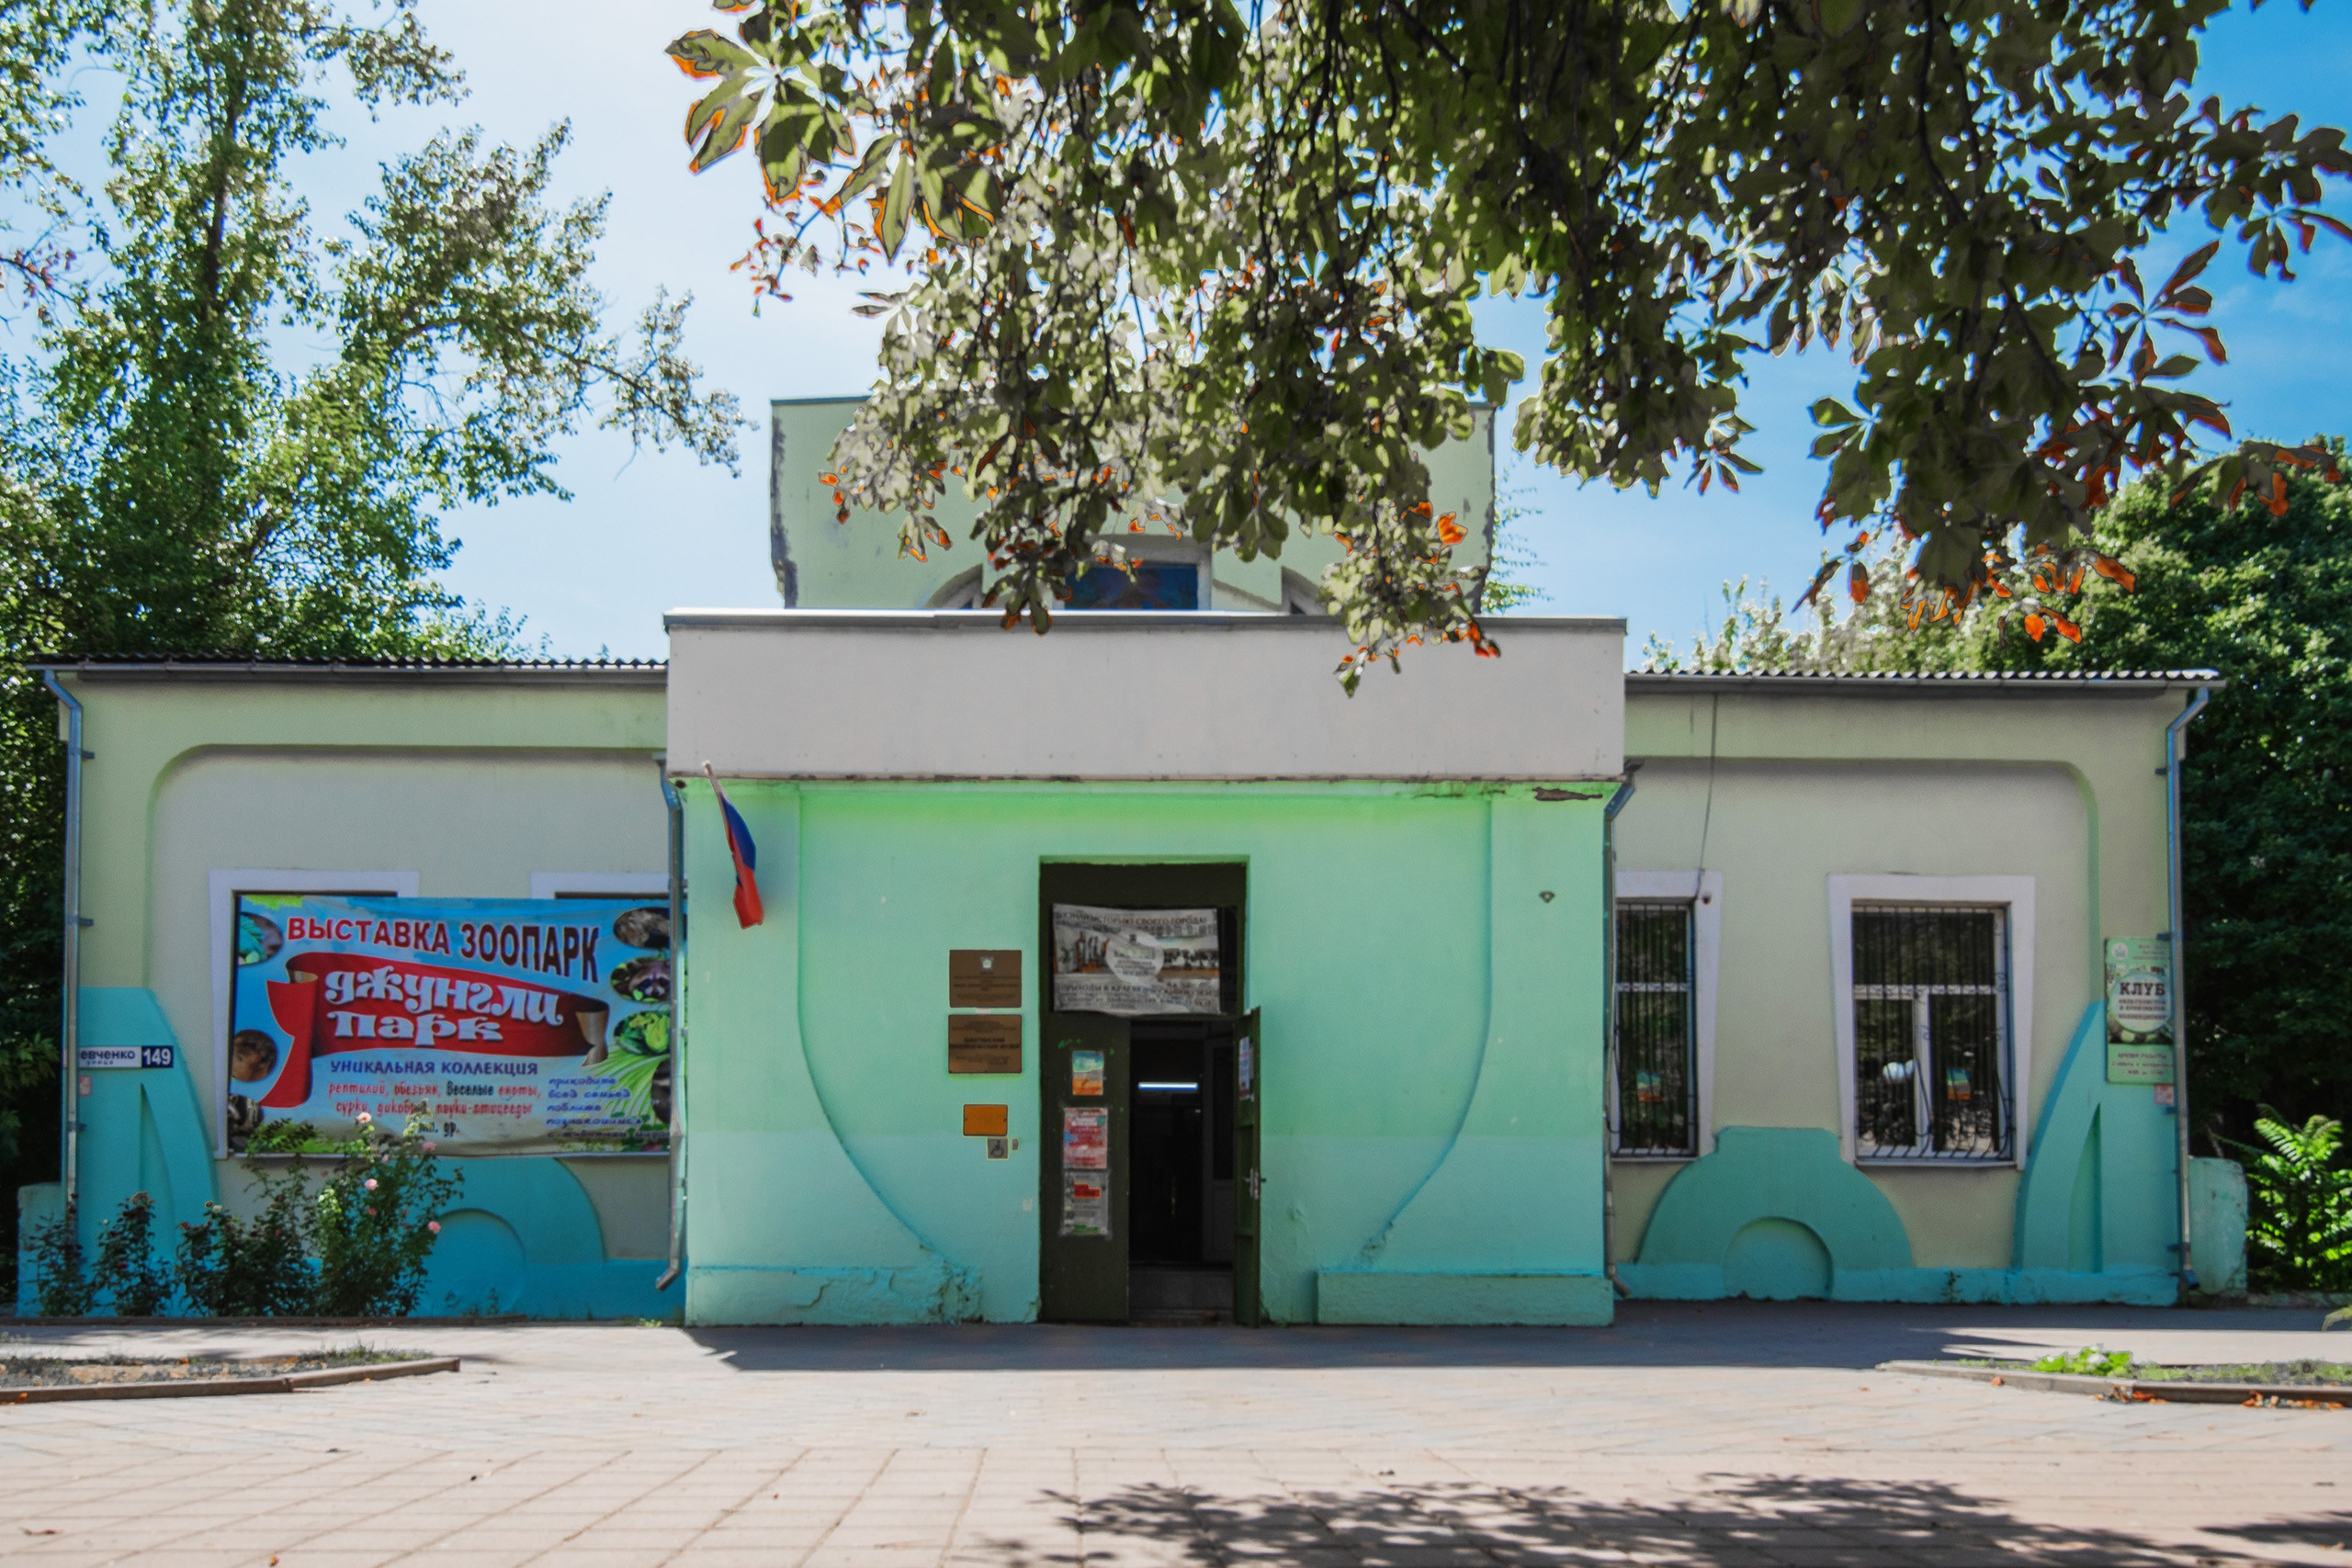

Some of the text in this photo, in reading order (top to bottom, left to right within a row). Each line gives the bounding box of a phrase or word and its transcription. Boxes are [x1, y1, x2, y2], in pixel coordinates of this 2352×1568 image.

[288, 917, 599, 983] ВЫСТАВКА ЗООПАРК
[2119, 982, 2165, 996] КЛУБ
[80, 1047, 172, 1066] евченко 149
[330, 1059, 538, 1077] УНИКАЛЬНАЯ КОЛЛЕКЦИЯ
